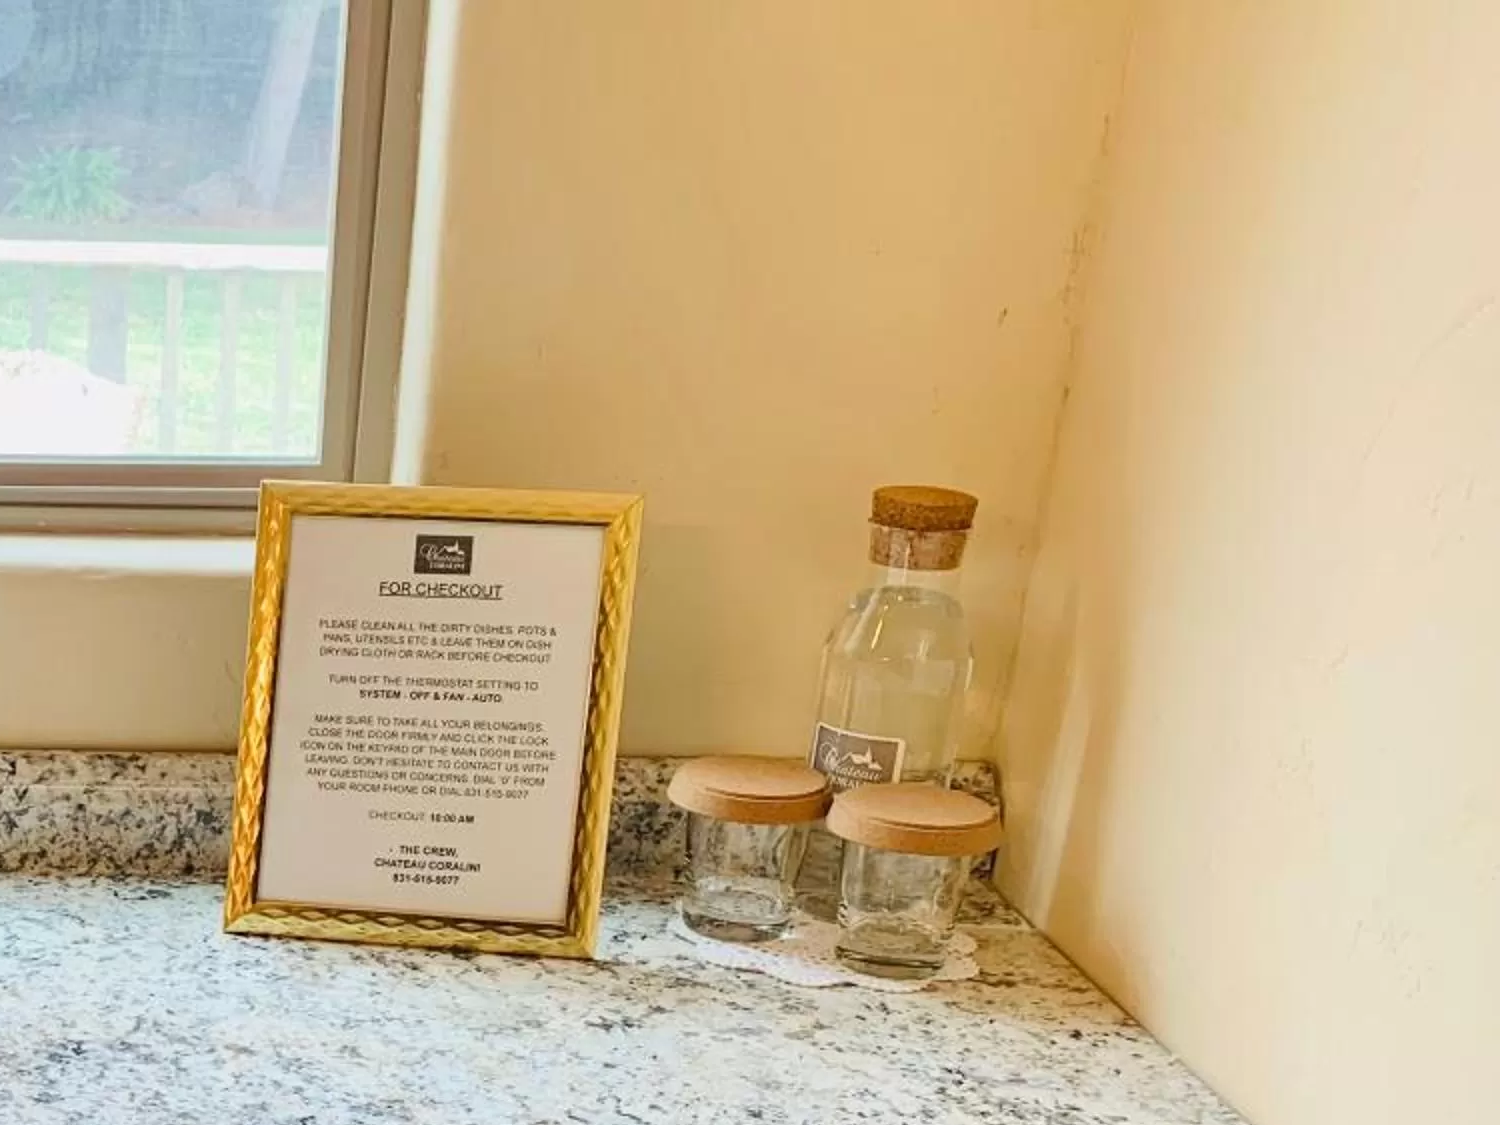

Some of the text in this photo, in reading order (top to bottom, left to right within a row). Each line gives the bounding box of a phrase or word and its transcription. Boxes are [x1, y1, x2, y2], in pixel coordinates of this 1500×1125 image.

[379, 581, 503, 599] FOR CHECKOUT
[319, 619, 357, 629] PLEASE
[361, 620, 395, 631] CLEAN
[398, 621, 413, 631] ALL
[420, 622, 436, 632] THE
[440, 623, 470, 633] DIRTY
[518, 625, 546, 636] POTS
[356, 634, 404, 645] UTENSILS
[408, 635, 428, 646] ETC
[440, 637, 472, 647] LEAVE
[476, 638, 505, 648] THEM
[508, 639, 523, 649] ON
[526, 640, 551, 650] DISH
[319, 646, 551, 663] DRYING CLOTH OR RACK BEFORE CHECKOUT
[329, 674, 539, 691] TURN OFF THE THERMOSTAT SETTING TO
[360, 689, 400, 699] SYSTEM
[409, 691, 430, 701] OFF
[443, 692, 464, 702] FAN
[472, 693, 502, 703] AUTO
[315, 714, 342, 724] MAKE
[346, 715, 373, 725] SURE
[377, 716, 390, 726] TO
[393, 716, 418, 727] TAKE
[420, 718, 438, 728] ALL
[441, 719, 470, 729] YOUR
[308, 727, 548, 746] CLOSE THE DOOR FIRMLY AND CLICK THE LOCK
[300, 740, 556, 761] ICON ON THE KEYPAD OF THE MAIN DOOR BEFORE
[386, 757, 435, 769] HESITATE
[438, 759, 450, 769] TO
[454, 760, 501, 771] CONTACT
[505, 762, 518, 772] US
[522, 762, 548, 773] WITH
[307, 767, 327, 777] ANY
[329, 767, 388, 780] QUESTIONS
[391, 771, 406, 781] OR
[474, 774, 496, 785] DIAL
[514, 775, 545, 787] FROM
[318, 781, 347, 791] YOUR
[349, 782, 380, 793] ROOM
[383, 783, 418, 794] PHONE
[421, 785, 436, 795] OR
[439, 786, 462, 796] DIAL
[458, 814, 475, 824] AM
[399, 845, 420, 855] THE
[374, 857, 481, 872] CHATEAU CORALINI
